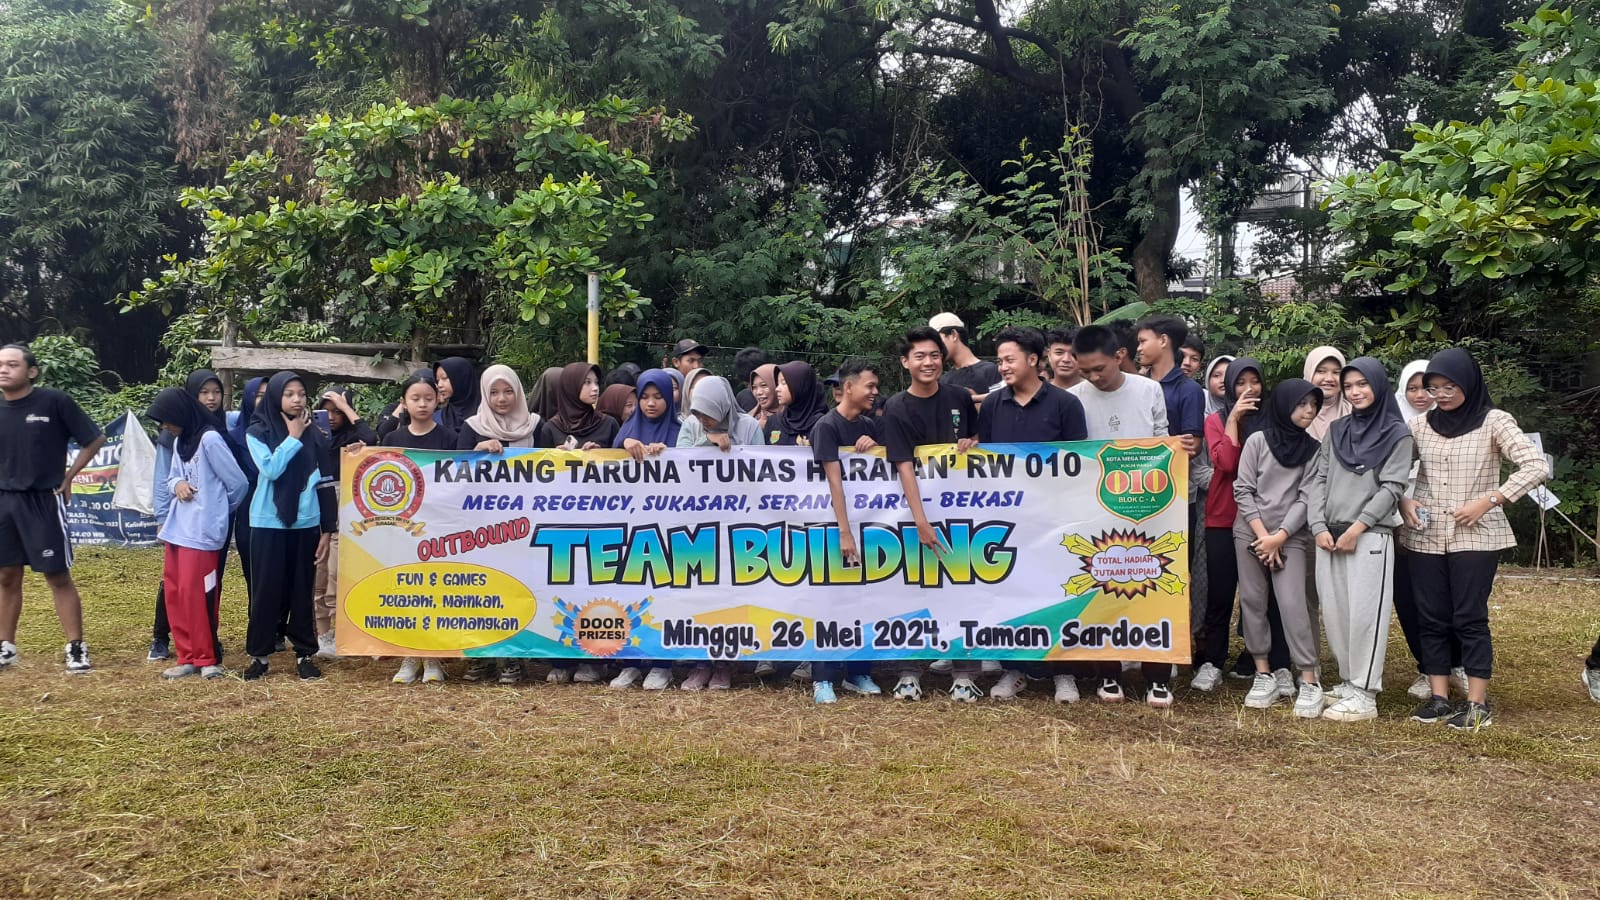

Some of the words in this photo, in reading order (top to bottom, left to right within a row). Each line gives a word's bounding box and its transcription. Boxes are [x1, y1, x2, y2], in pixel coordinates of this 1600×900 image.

[434, 459, 555, 484] KARANG
[565, 459, 681, 484] TARUNA
[967, 453, 1015, 479] RW
[1026, 451, 1082, 479] 010
[1105, 468, 1169, 495] 010
[462, 495, 524, 511] MEGA
[532, 494, 635, 514] REGENCY,
[642, 494, 751, 513] SUKASARI,
[758, 493, 834, 512] SERAN
[940, 490, 1025, 509] BEKASI
[417, 516, 531, 562] OUTBOUND
[529, 521, 721, 589] TEAM
[728, 519, 1018, 589] BUILDING
[1096, 557, 1122, 565] TOTAL
[1124, 555, 1154, 564] HADIAH
[397, 572, 423, 586] FUN
[429, 572, 438, 588] &
[443, 572, 487, 586] GAMES
[1093, 568, 1126, 577] JUTAAN
[1127, 567, 1157, 576] RUPIAH
[378, 594, 437, 609] Jelajahi,
[442, 594, 504, 610] Mainkan,
[364, 615, 417, 630] Nikmati
[436, 616, 519, 631] menangkan
[580, 617, 625, 630] DOOR
[578, 630, 626, 640] PRIZES!
[662, 619, 760, 659] Minggu,
[771, 620, 805, 648] 26
[816, 620, 862, 647] Mei
[873, 619, 948, 650] 2024,
[959, 620, 1049, 648] Taman
[1061, 618, 1170, 649] Sardoel
